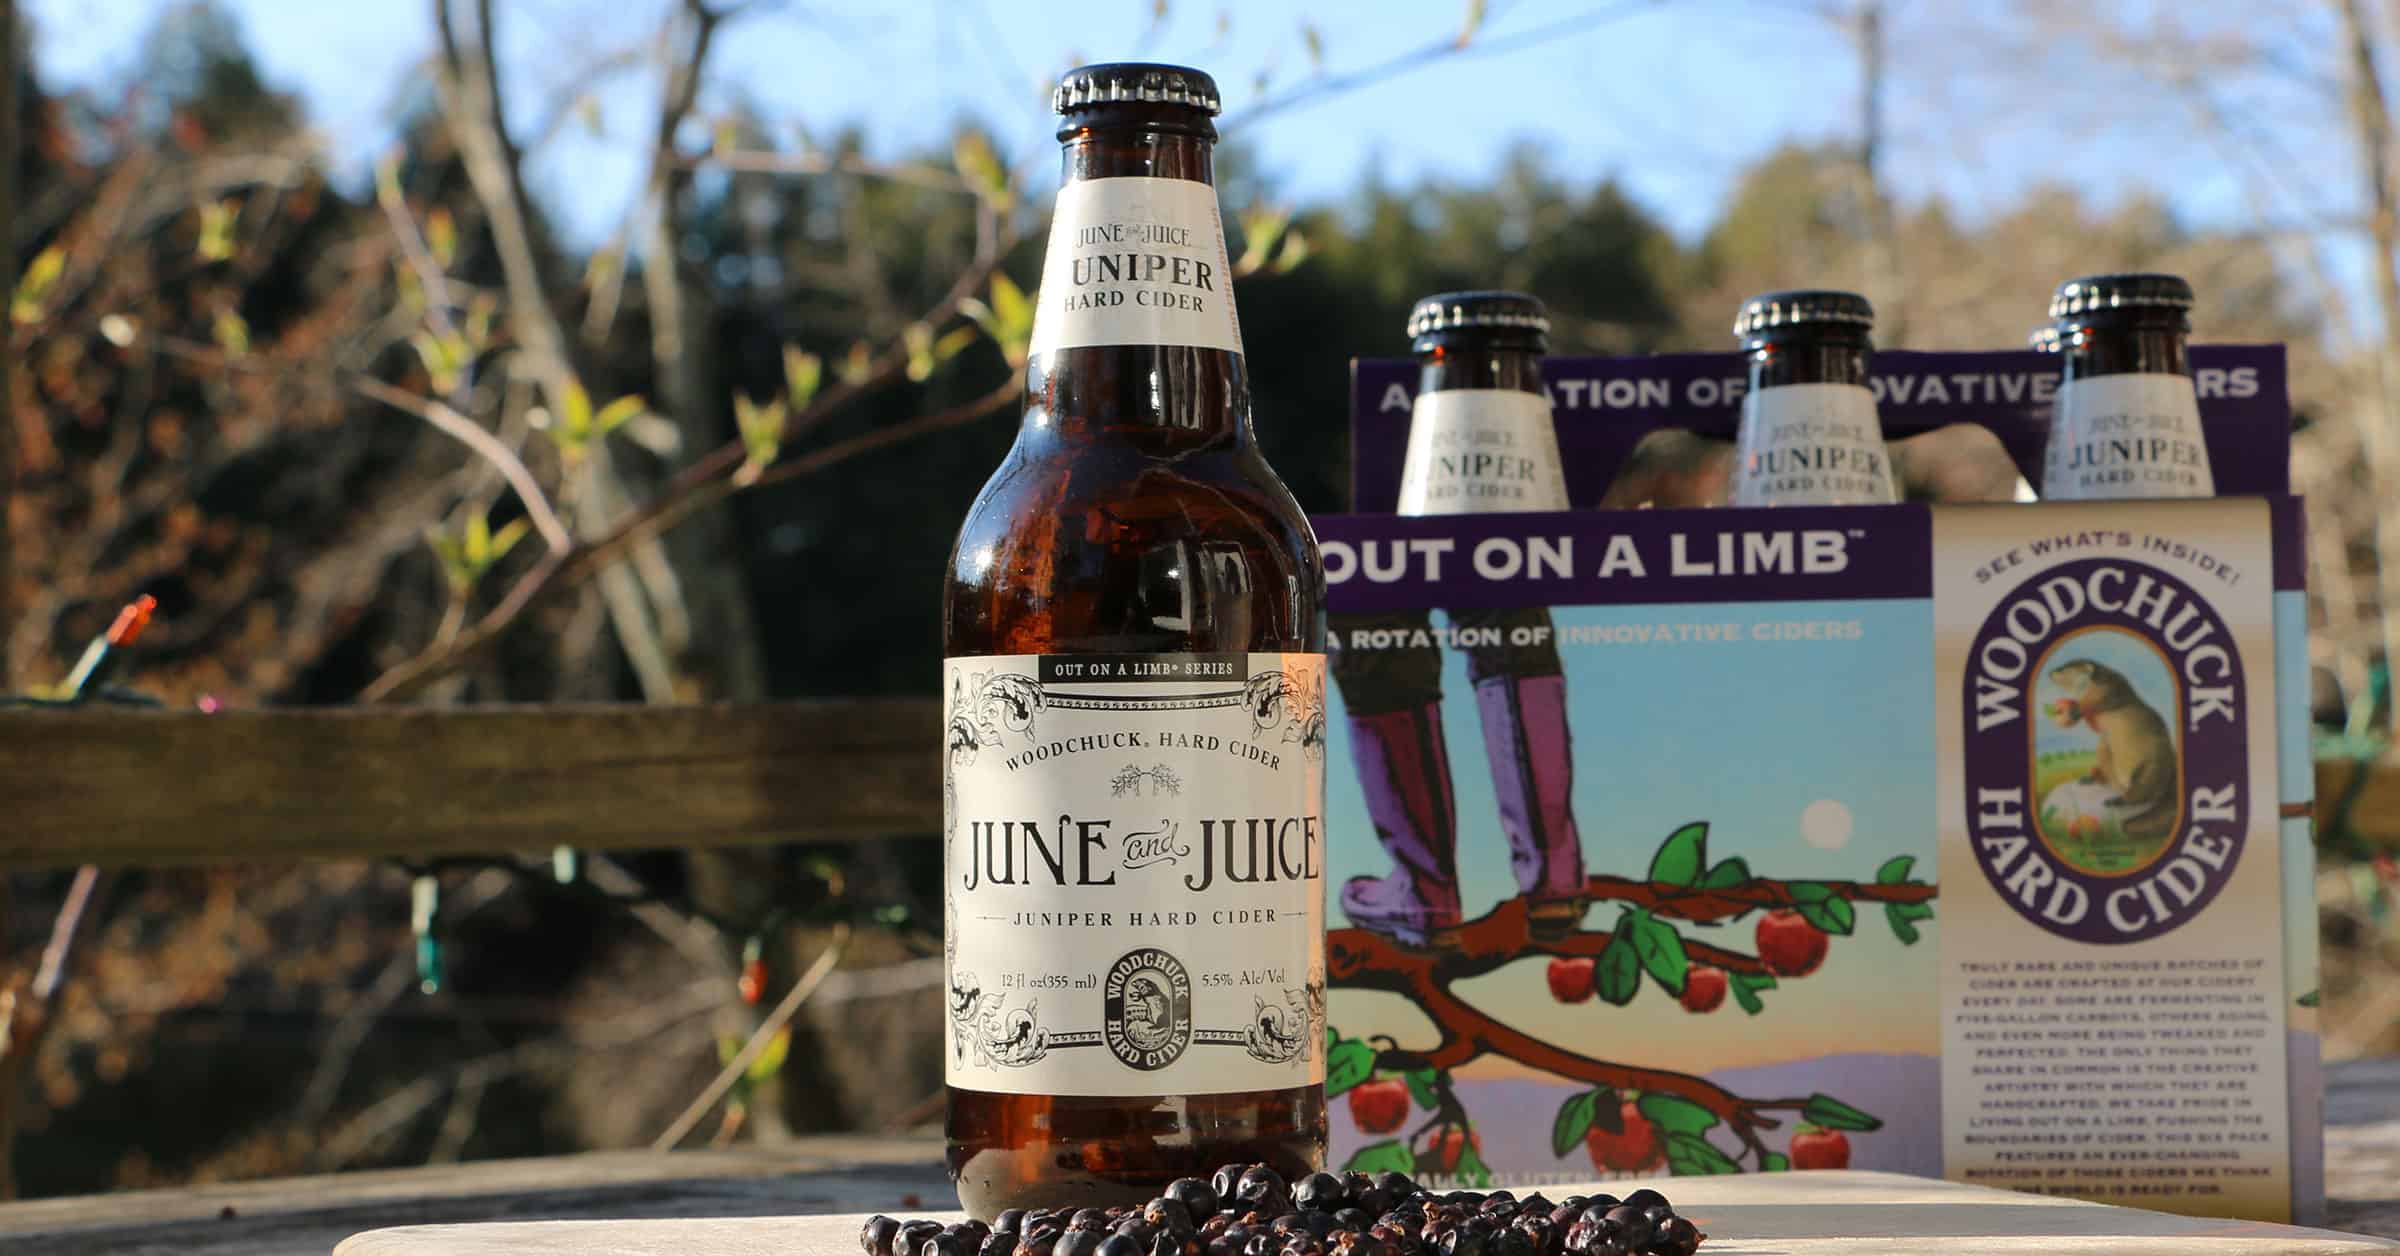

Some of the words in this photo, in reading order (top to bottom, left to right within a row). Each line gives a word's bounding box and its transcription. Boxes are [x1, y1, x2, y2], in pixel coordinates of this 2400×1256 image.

[1077, 223, 1124, 248] JUNE
[1141, 225, 1191, 247] JUICE
[1072, 253, 1214, 292] UNIPER
[1064, 290, 1124, 312] HARD
[1136, 290, 1203, 312] CIDER
[1687, 378, 1746, 408] OF
[1438, 453, 1537, 482] NIPER
[1750, 446, 1884, 478] JUNIPER
[2068, 437, 2203, 471] JUNIPER
[1319, 537, 1455, 584] OUT
[1473, 536, 1573, 581] ON
[1598, 535, 1647, 578] A
[1975, 549, 2023, 584] SEE
[2030, 530, 2132, 557] WHAT'S
[2143, 535, 2241, 587] INSIDE!
[1326, 633, 1341, 650] A
[1351, 627, 1501, 649] ROTATION
[1510, 626, 1550, 646] OF
[1560, 622, 1744, 645] INNOVATIVE
[1752, 619, 1864, 641] CIDERS
[1055, 664, 1083, 676] OUT
[1090, 664, 1110, 676] ON
[1117, 664, 1127, 676] A
[1184, 663, 1233, 675] SERIES
[1159, 732, 1220, 751] HARD
[1229, 740, 1281, 770] CIDER
[964, 814, 1116, 891] JUNE
[1122, 818, 1190, 870] and
[1184, 816, 1319, 892] JUICE
[1977, 786, 2089, 925] HARD
[2105, 783, 2237, 933] CIDER
[1013, 912, 1113, 927] JUNIPER
[1130, 911, 1197, 926] HARD
[1213, 908, 1277, 924] CIDER
[1001, 974, 1013, 987] 12
[1015, 973, 1025, 989] fl
[1075, 973, 1097, 989] ml)
[1107, 952, 1189, 999] WOODCHUCK
[1201, 973, 1234, 987] 5.5%
[1239, 968, 1288, 985] Alc/Vol
[1107, 1019, 1140, 1063] HARD
[1145, 1019, 1189, 1067] CIDER
